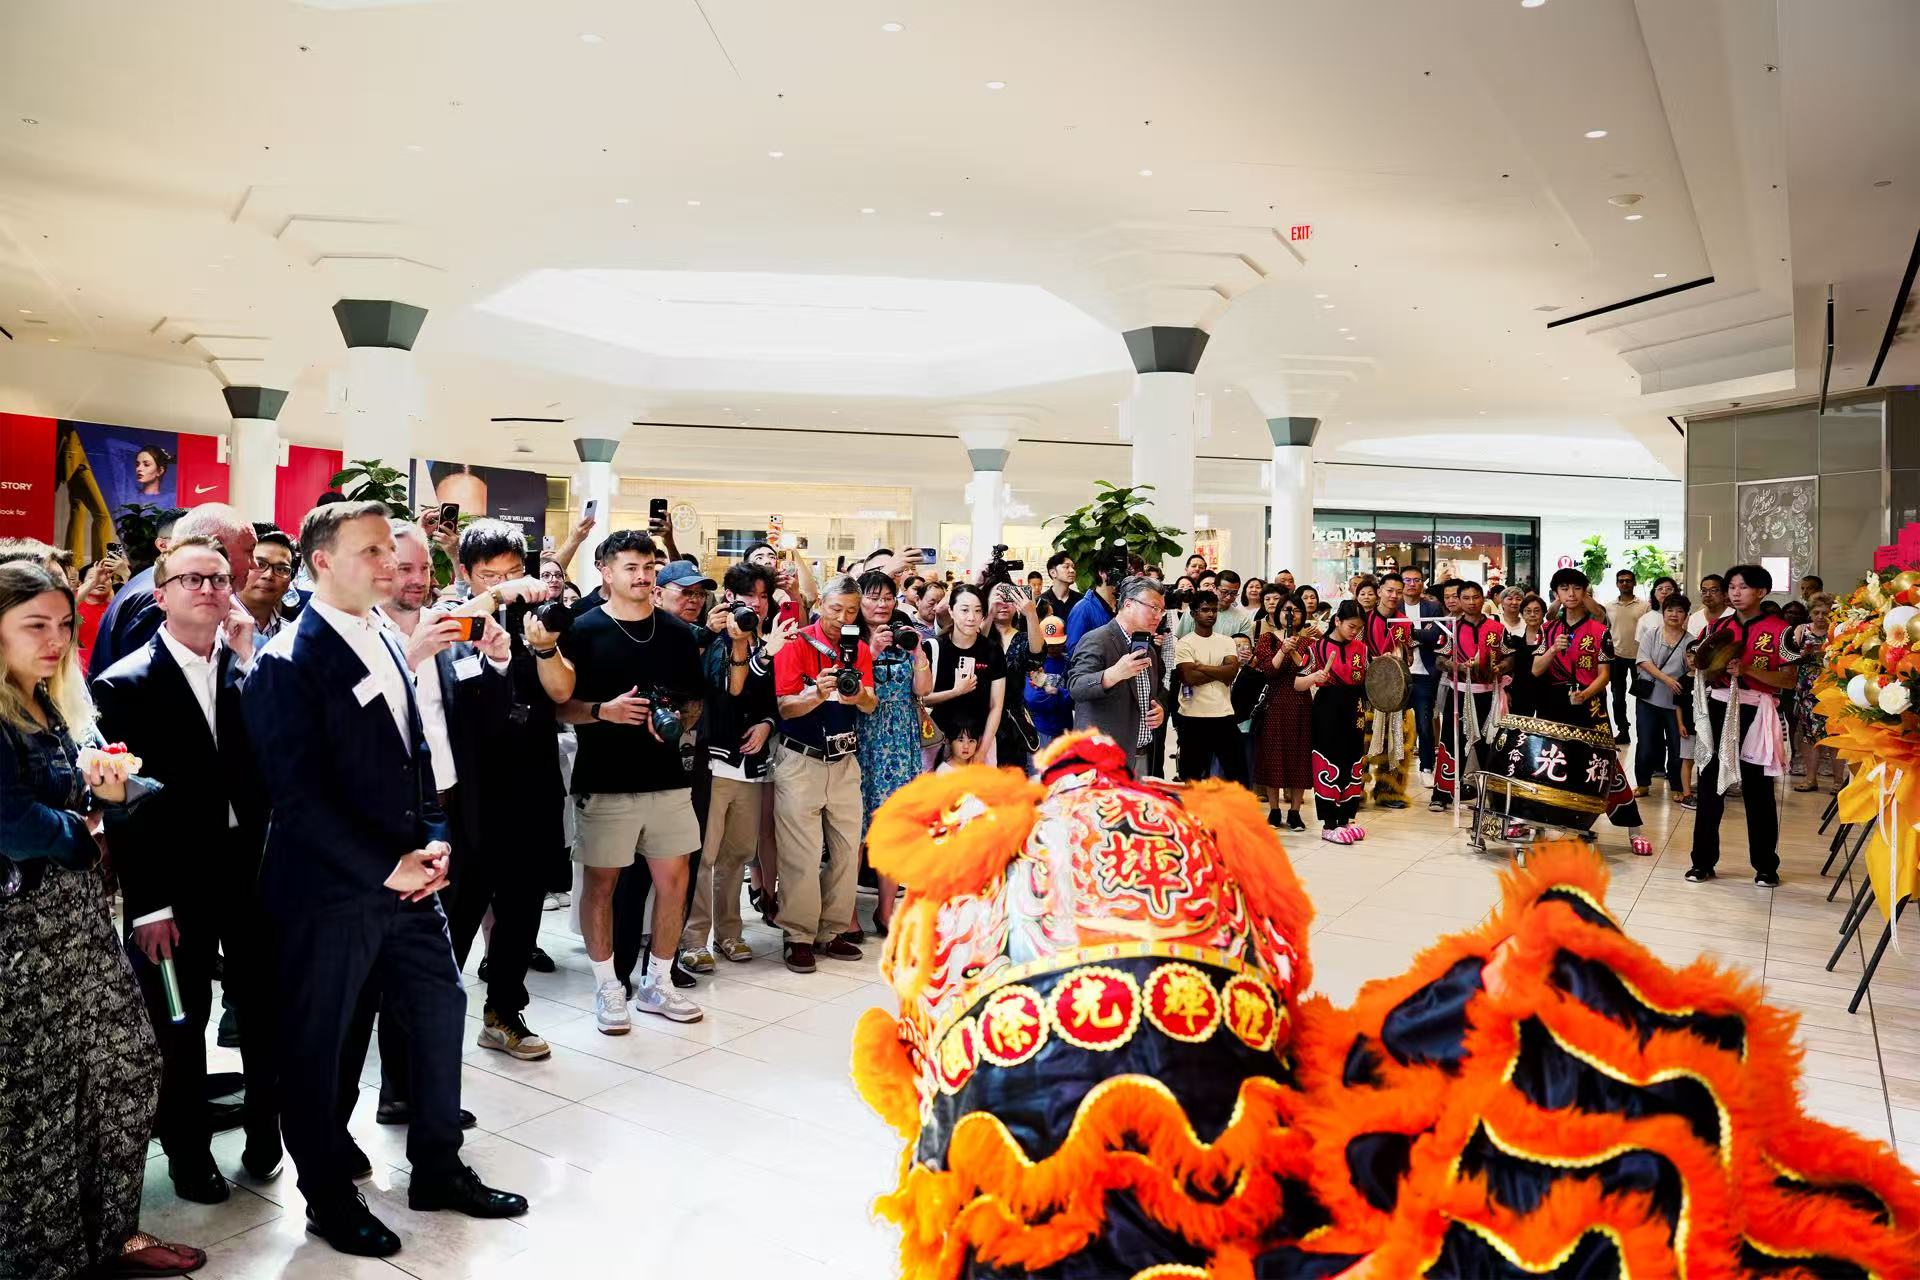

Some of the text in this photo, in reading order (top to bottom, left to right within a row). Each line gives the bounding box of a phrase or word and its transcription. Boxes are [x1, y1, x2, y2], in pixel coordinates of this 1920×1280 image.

[1291, 225, 1310, 241] EXIT
[1, 481, 32, 490] STORY
[1344, 528, 1376, 542] Rose
